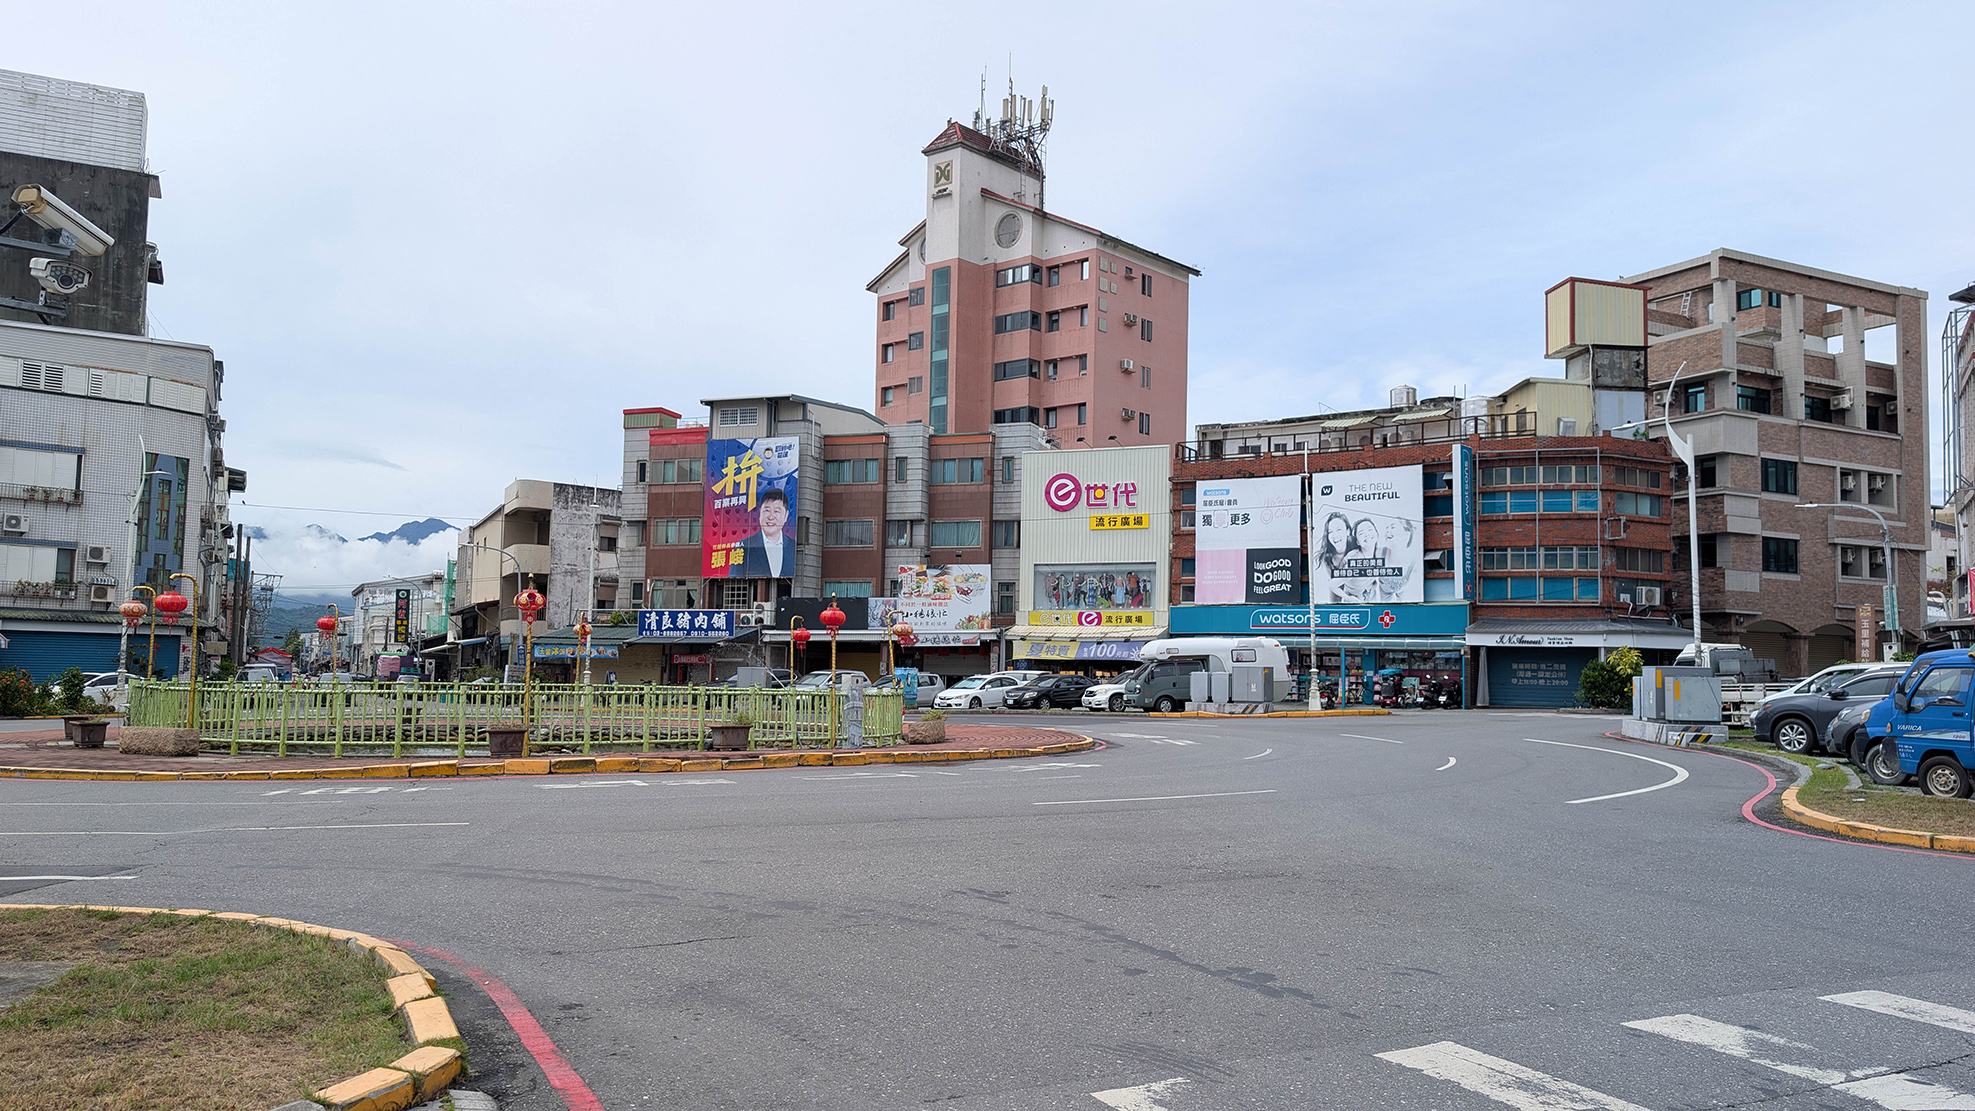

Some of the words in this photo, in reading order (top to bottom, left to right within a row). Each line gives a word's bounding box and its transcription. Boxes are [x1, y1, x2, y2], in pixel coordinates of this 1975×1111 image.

[1046, 475, 1138, 510] e世代
[1349, 484, 1367, 493] THE
[1369, 482, 1393, 491] NEW
[714, 495, 747, 509] 百業再興
[1344, 492, 1400, 502] BEAUTIFUL
[1095, 516, 1143, 527] 流行廣場
[1253, 561, 1266, 570] LOOK
[1265, 559, 1291, 569] GOOD
[1254, 572, 1272, 583] DO
[1273, 570, 1291, 581] GOOD
[1253, 586, 1264, 594] FEEL
[1263, 584, 1292, 593] GREAT
[1105, 615, 1143, 624] 流行廣場
[1329, 613, 1360, 624] 屈臣氏
[1026, 642, 1071, 657] 夏特賣
[1089, 643, 1117, 658] 100
